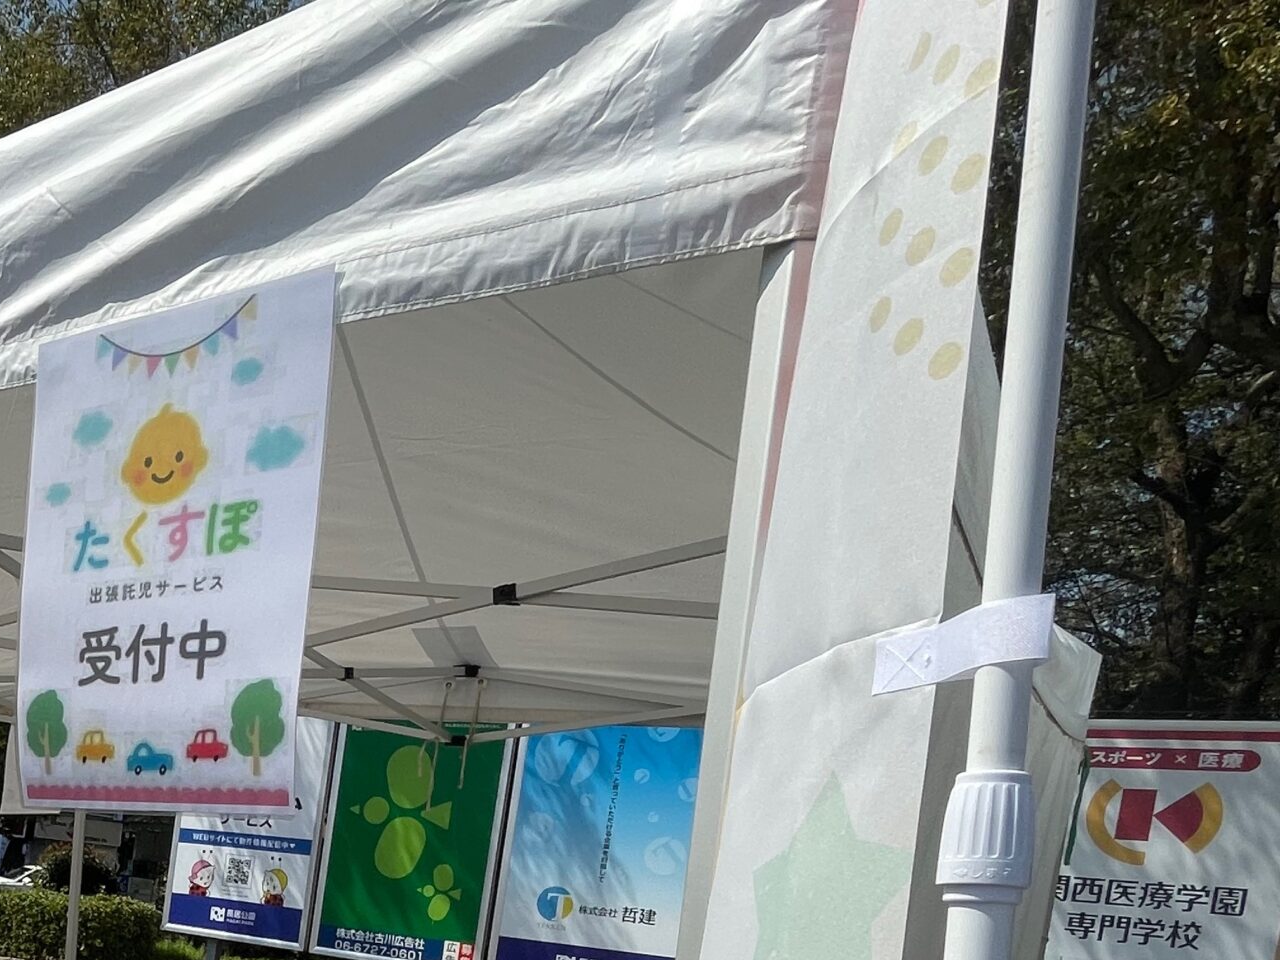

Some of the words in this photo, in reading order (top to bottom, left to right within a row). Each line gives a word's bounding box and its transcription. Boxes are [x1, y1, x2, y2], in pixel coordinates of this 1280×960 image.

[73, 500, 258, 571] たくすぽ
[89, 575, 224, 604] 出張託児サービス
[78, 618, 227, 687] 受付中
[1090, 750, 1162, 765] スポーツ
[1197, 752, 1245, 769] 医療
[579, 905, 618, 918] 株式会社
[622, 906, 657, 926] 哲建
[335, 928, 426, 950] 株式会社古川広告社
[1064, 911, 1202, 950] 専門学校
[334, 939, 423, 960] 06-6727-0601
